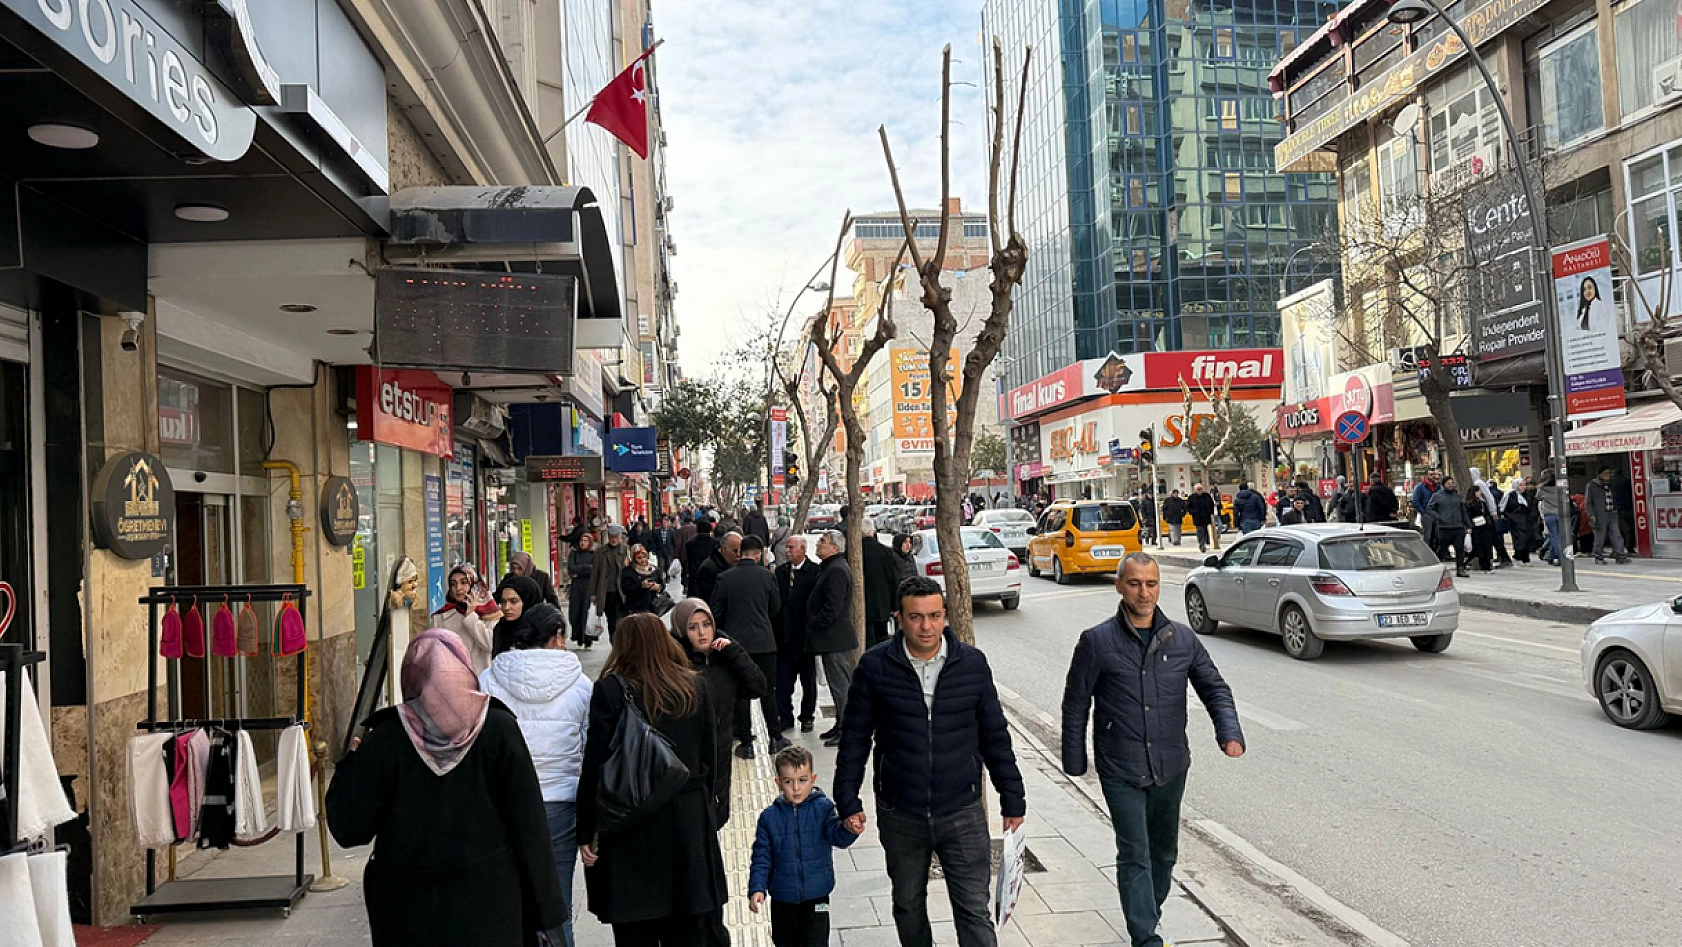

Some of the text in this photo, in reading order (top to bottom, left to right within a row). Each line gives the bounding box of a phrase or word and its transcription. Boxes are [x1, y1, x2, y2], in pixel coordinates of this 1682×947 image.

[1482, 312, 1540, 337] Independent
[1479, 328, 1545, 352] Repair Provider
[1191, 354, 1273, 379] final
[901, 382, 922, 397] 15
[1013, 379, 1066, 416] final kurs
[382, 381, 438, 427] etstur
[901, 440, 935, 449] evm
[1633, 450, 1647, 530] czane
